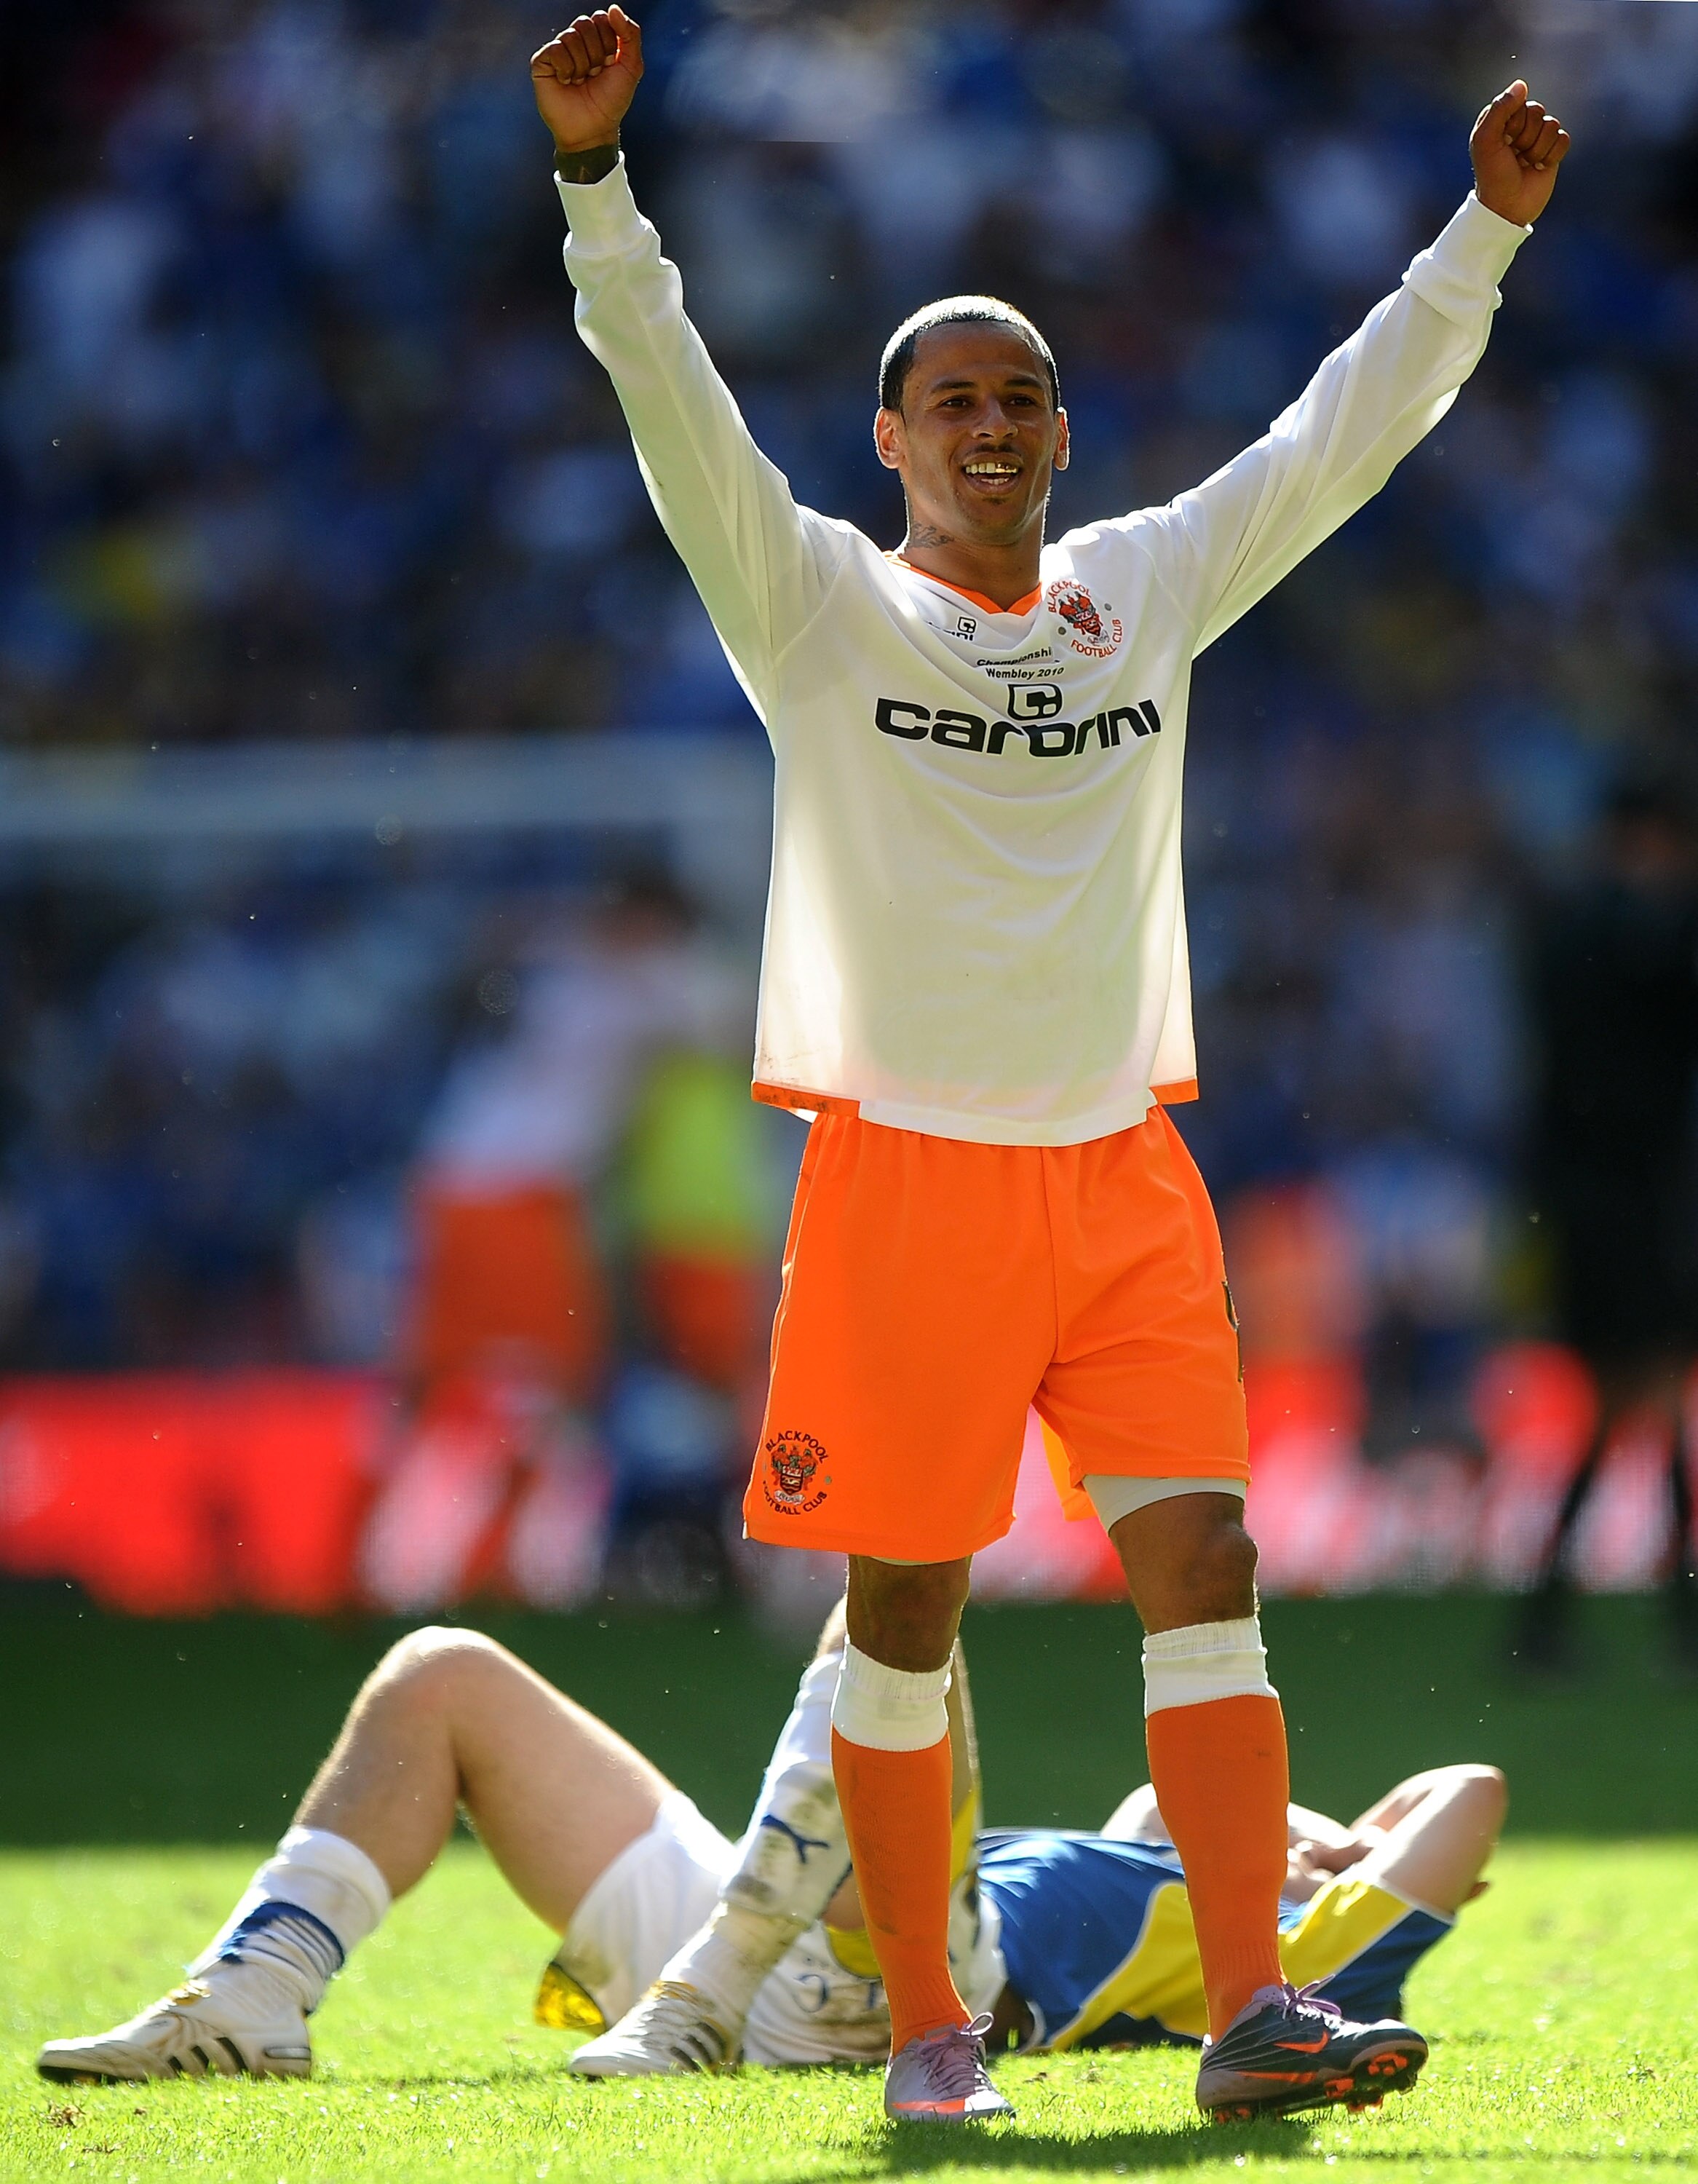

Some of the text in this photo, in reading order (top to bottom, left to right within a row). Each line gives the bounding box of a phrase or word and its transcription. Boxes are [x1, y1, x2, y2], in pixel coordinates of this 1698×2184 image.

[1047, 580, 1092, 613] BLACKPOOL
[1071, 639, 1117, 658] FOOTBALL
[1112, 619, 1122, 643] CLUB
[976, 646, 1052, 666] Championshi
[985, 667, 1064, 681] Wembley 2010
[765, 1430, 830, 1464] BLACKPOOL
[763, 1479, 801, 1515] OTBALL
[802, 1491, 828, 1512] CLUB
